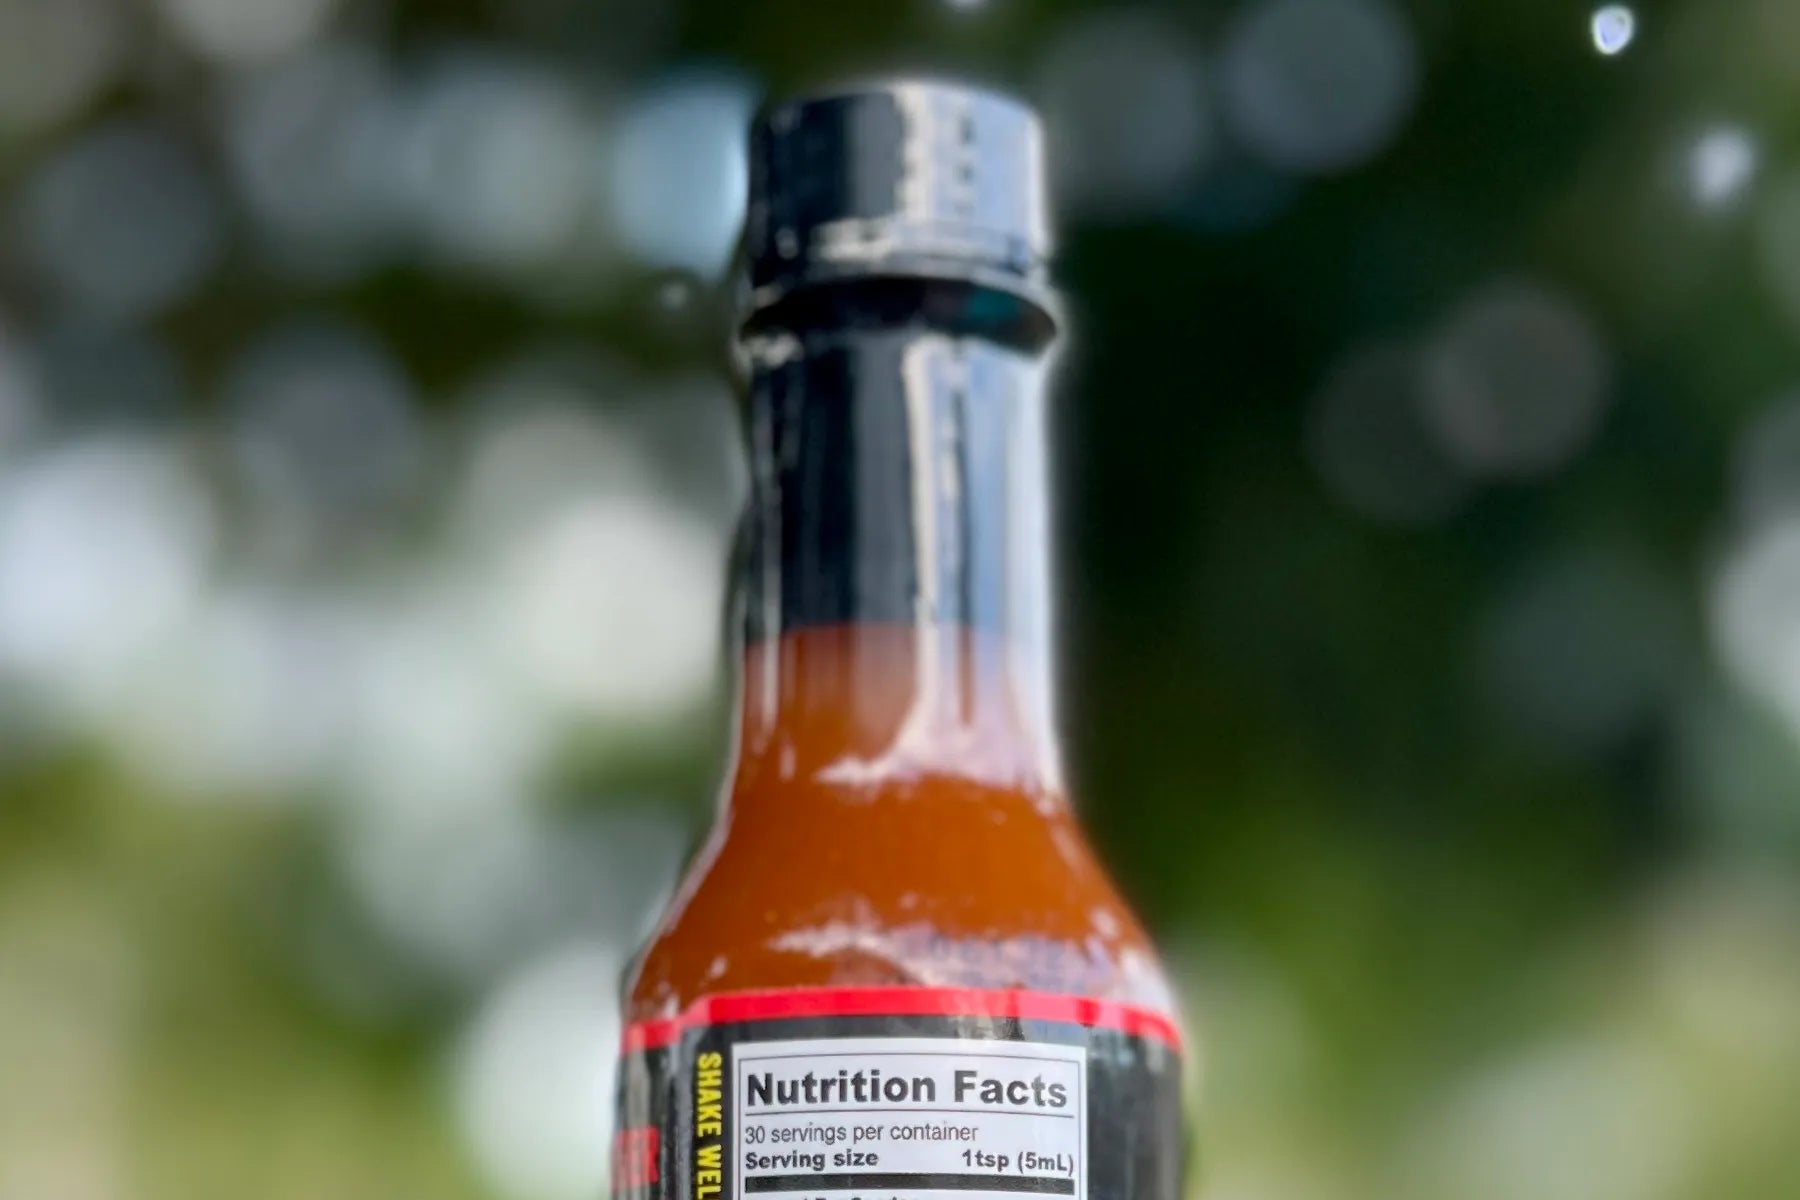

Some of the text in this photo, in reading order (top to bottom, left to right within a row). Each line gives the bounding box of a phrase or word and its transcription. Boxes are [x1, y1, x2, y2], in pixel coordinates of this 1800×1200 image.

[697, 1053, 723, 1137] SHAKE
[746, 1069, 1068, 1107] Nutrition Facts
[745, 1122, 979, 1145] 30 servings per container
[745, 1149, 879, 1171] Serving size
[1018, 1152, 1074, 1176] (5mL)
